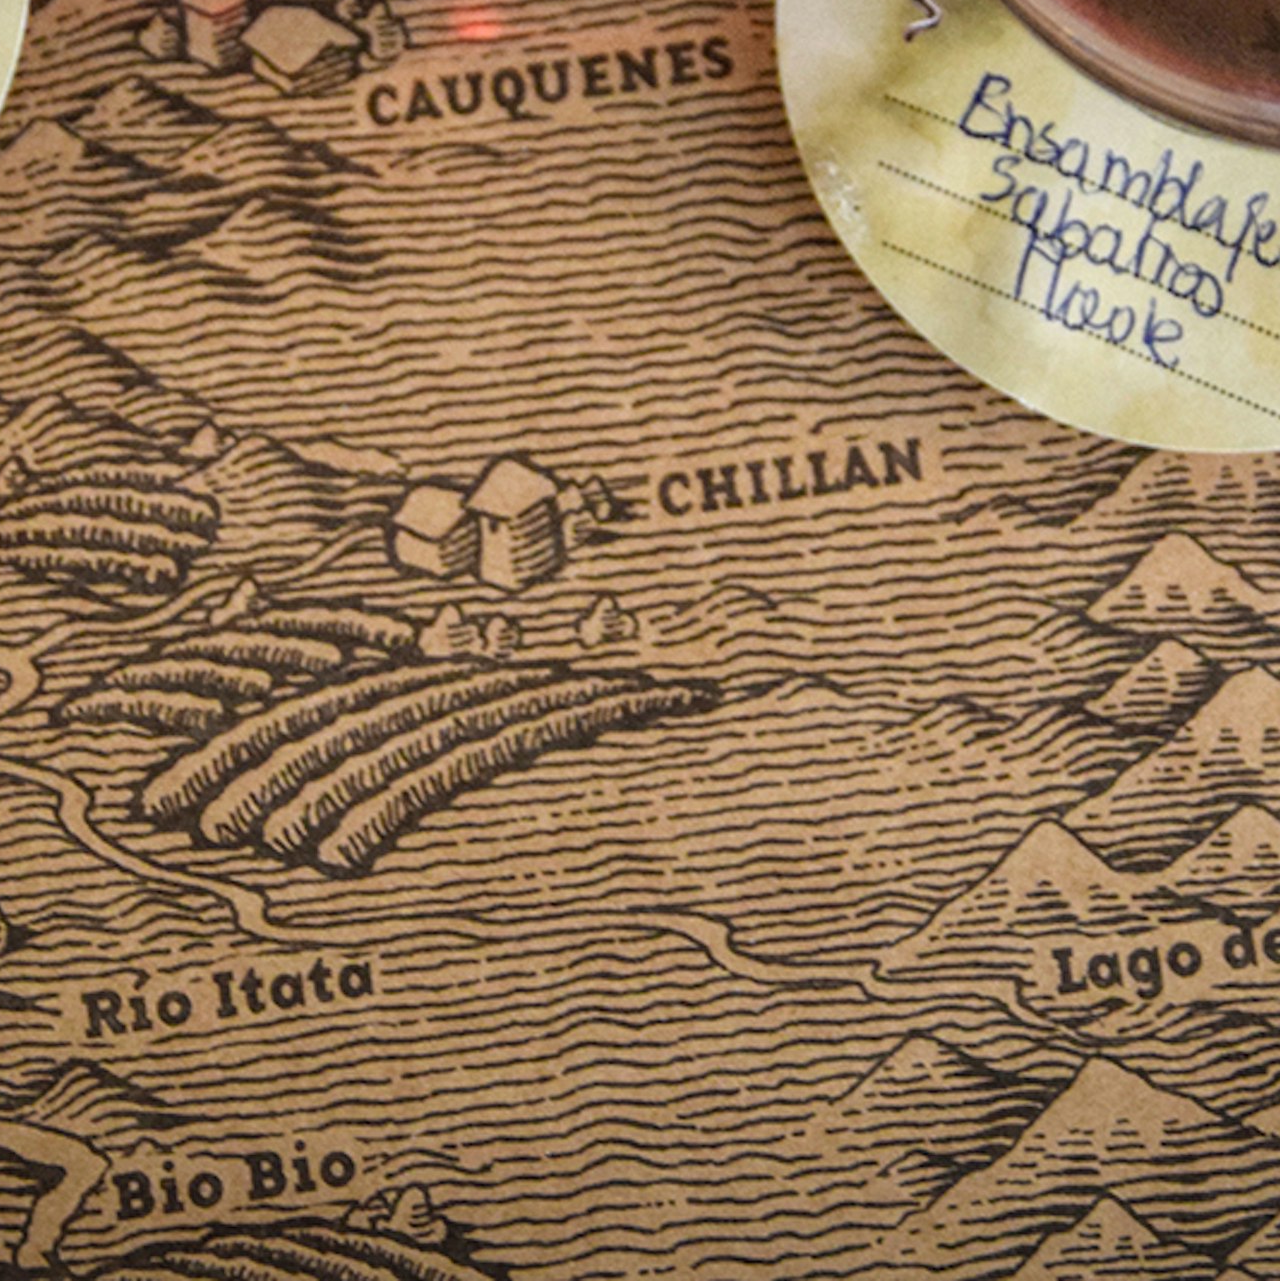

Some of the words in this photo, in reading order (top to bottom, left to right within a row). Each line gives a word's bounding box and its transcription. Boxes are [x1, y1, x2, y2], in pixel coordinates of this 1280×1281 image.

[367, 37, 735, 127] CAUQUENES
[213, 957, 374, 1016] Itata
[1051, 940, 1203, 999] Lago
[113, 1160, 221, 1220] Bio
[245, 1139, 356, 1200] Bio
